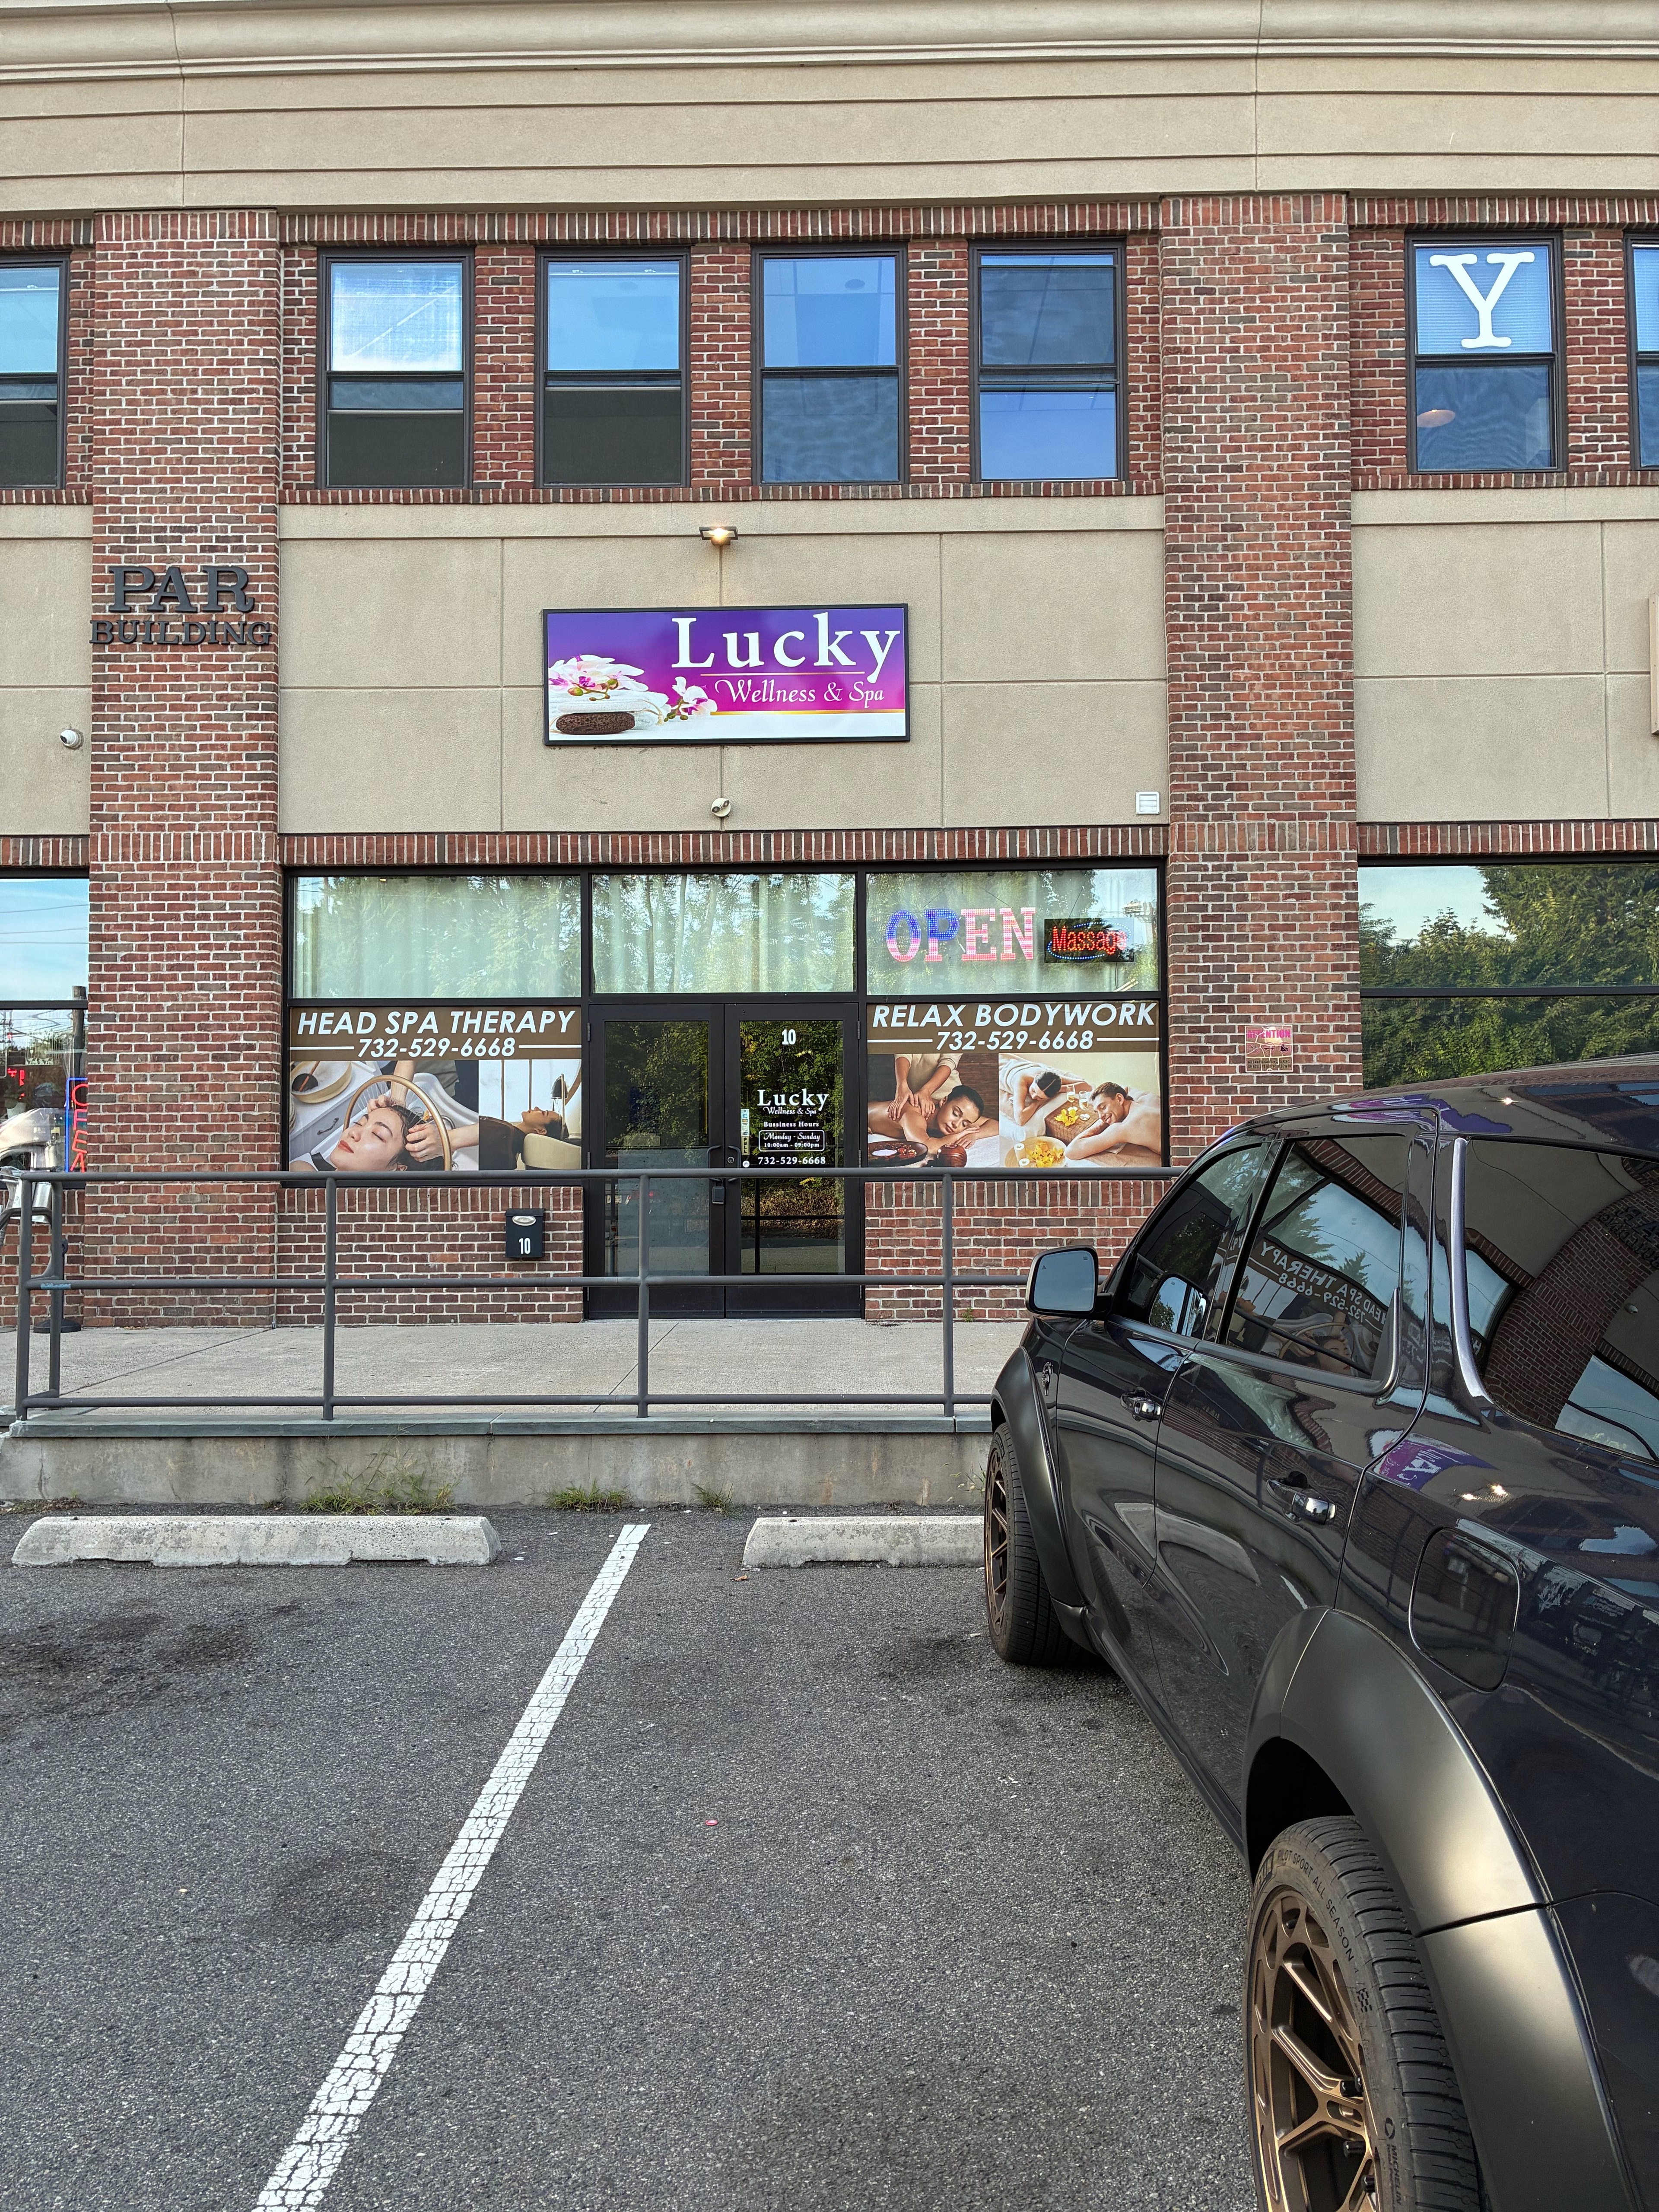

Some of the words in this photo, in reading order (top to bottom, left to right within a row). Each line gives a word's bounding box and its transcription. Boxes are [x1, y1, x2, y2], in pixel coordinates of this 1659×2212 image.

[1430, 251, 1535, 348] Y
[108, 566, 255, 613] PAR
[89, 620, 272, 645] BUILDING
[671, 611, 900, 683] Lucky
[715, 679, 816, 702] Wellness
[823, 682, 842, 702] &
[849, 681, 884, 709] Spa
[886, 907, 1036, 963] OPEN
[1052, 925, 1128, 955] Massage
[297, 1011, 376, 1035] HEAD
[385, 1011, 439, 1034] SPA
[450, 1010, 575, 1034] THERAPY
[872, 1004, 967, 1028] RELAX
[975, 1002, 1157, 1027] BODYWORK
[357, 1037, 515, 1058] 732-529-6668
[782, 1029, 796, 1045] 10
[936, 1030, 1093, 1051] 732-529-6668
[757, 1088, 830, 1111] Lucky
[763, 1106, 795, 1115] Wellness
[805, 1107, 817, 1116] Spa
[763, 1132, 791, 1142] Monday
[798, 1132, 820, 1142] Sunday
[758, 1156, 826, 1165] 732-529-6668
[519, 1238, 531, 1254] 10
[1292, 1853, 1313, 1877] SPORT
[1313, 1876, 1325, 1899] ALL
[1326, 1899, 1354, 1961] SEASON
